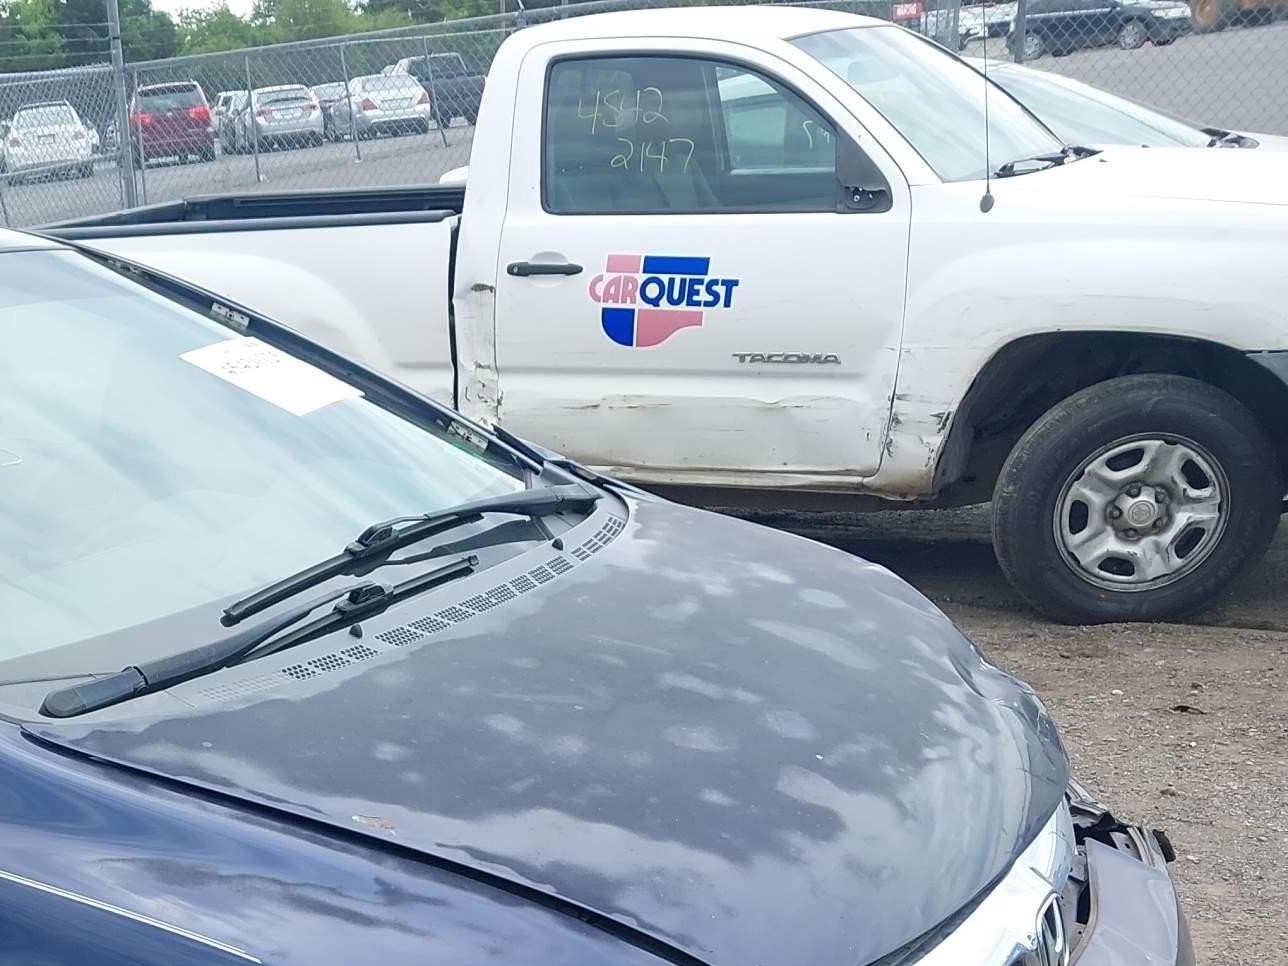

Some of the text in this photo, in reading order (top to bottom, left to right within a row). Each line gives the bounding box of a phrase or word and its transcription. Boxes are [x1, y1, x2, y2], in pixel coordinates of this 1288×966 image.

[578, 86, 669, 135] 4542
[610, 137, 695, 173] 2147
[588, 274, 739, 309] CARQUEST
[732, 351, 841, 365] TACOMA
